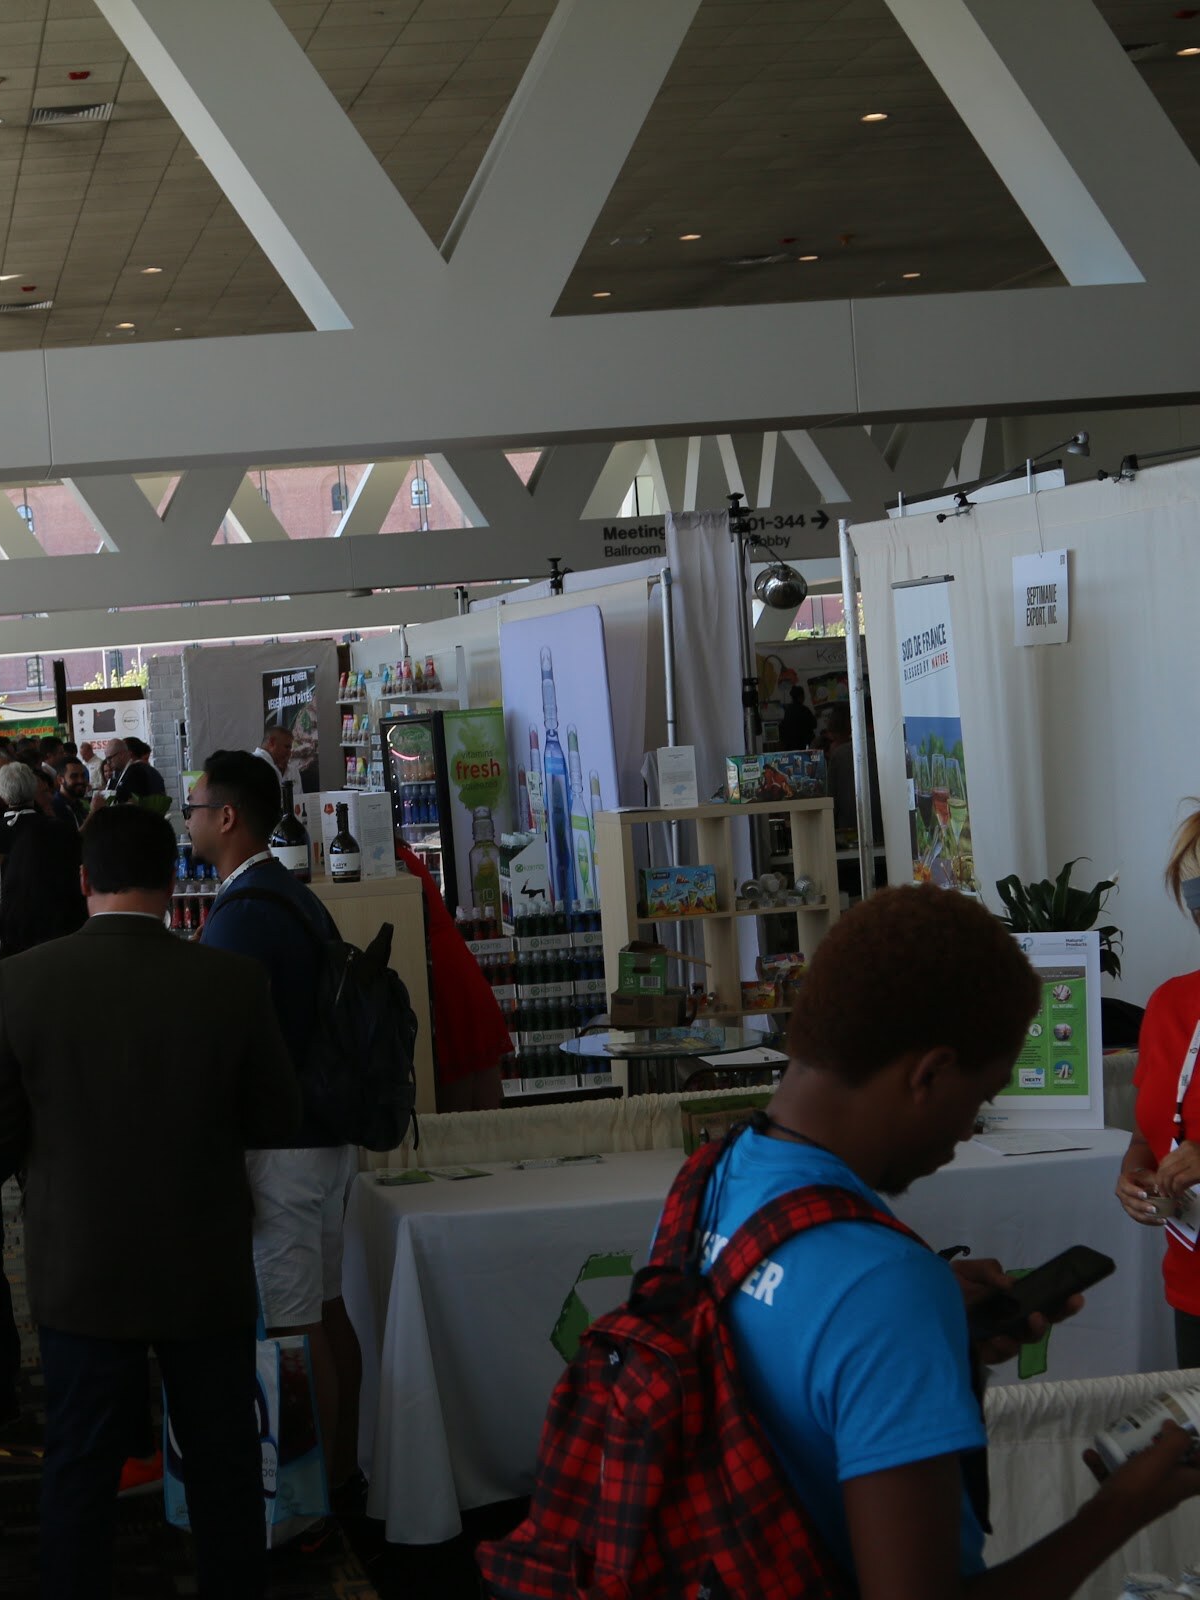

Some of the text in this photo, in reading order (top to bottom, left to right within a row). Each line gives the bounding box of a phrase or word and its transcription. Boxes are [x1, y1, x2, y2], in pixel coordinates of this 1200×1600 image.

[603, 525, 666, 541] Meeting
[744, 513, 806, 532] 01-344
[604, 545, 662, 558] Ballroom
[1026, 583, 1057, 606] SEPTIMANIE
[1026, 606, 1047, 628] EXPORT,
[901, 623, 947, 662] SUD DE FRANCE
[903, 651, 949, 681] BLESSED BY NATURE
[461, 751, 493, 759] vitamins
[455, 758, 501, 780] fresh
